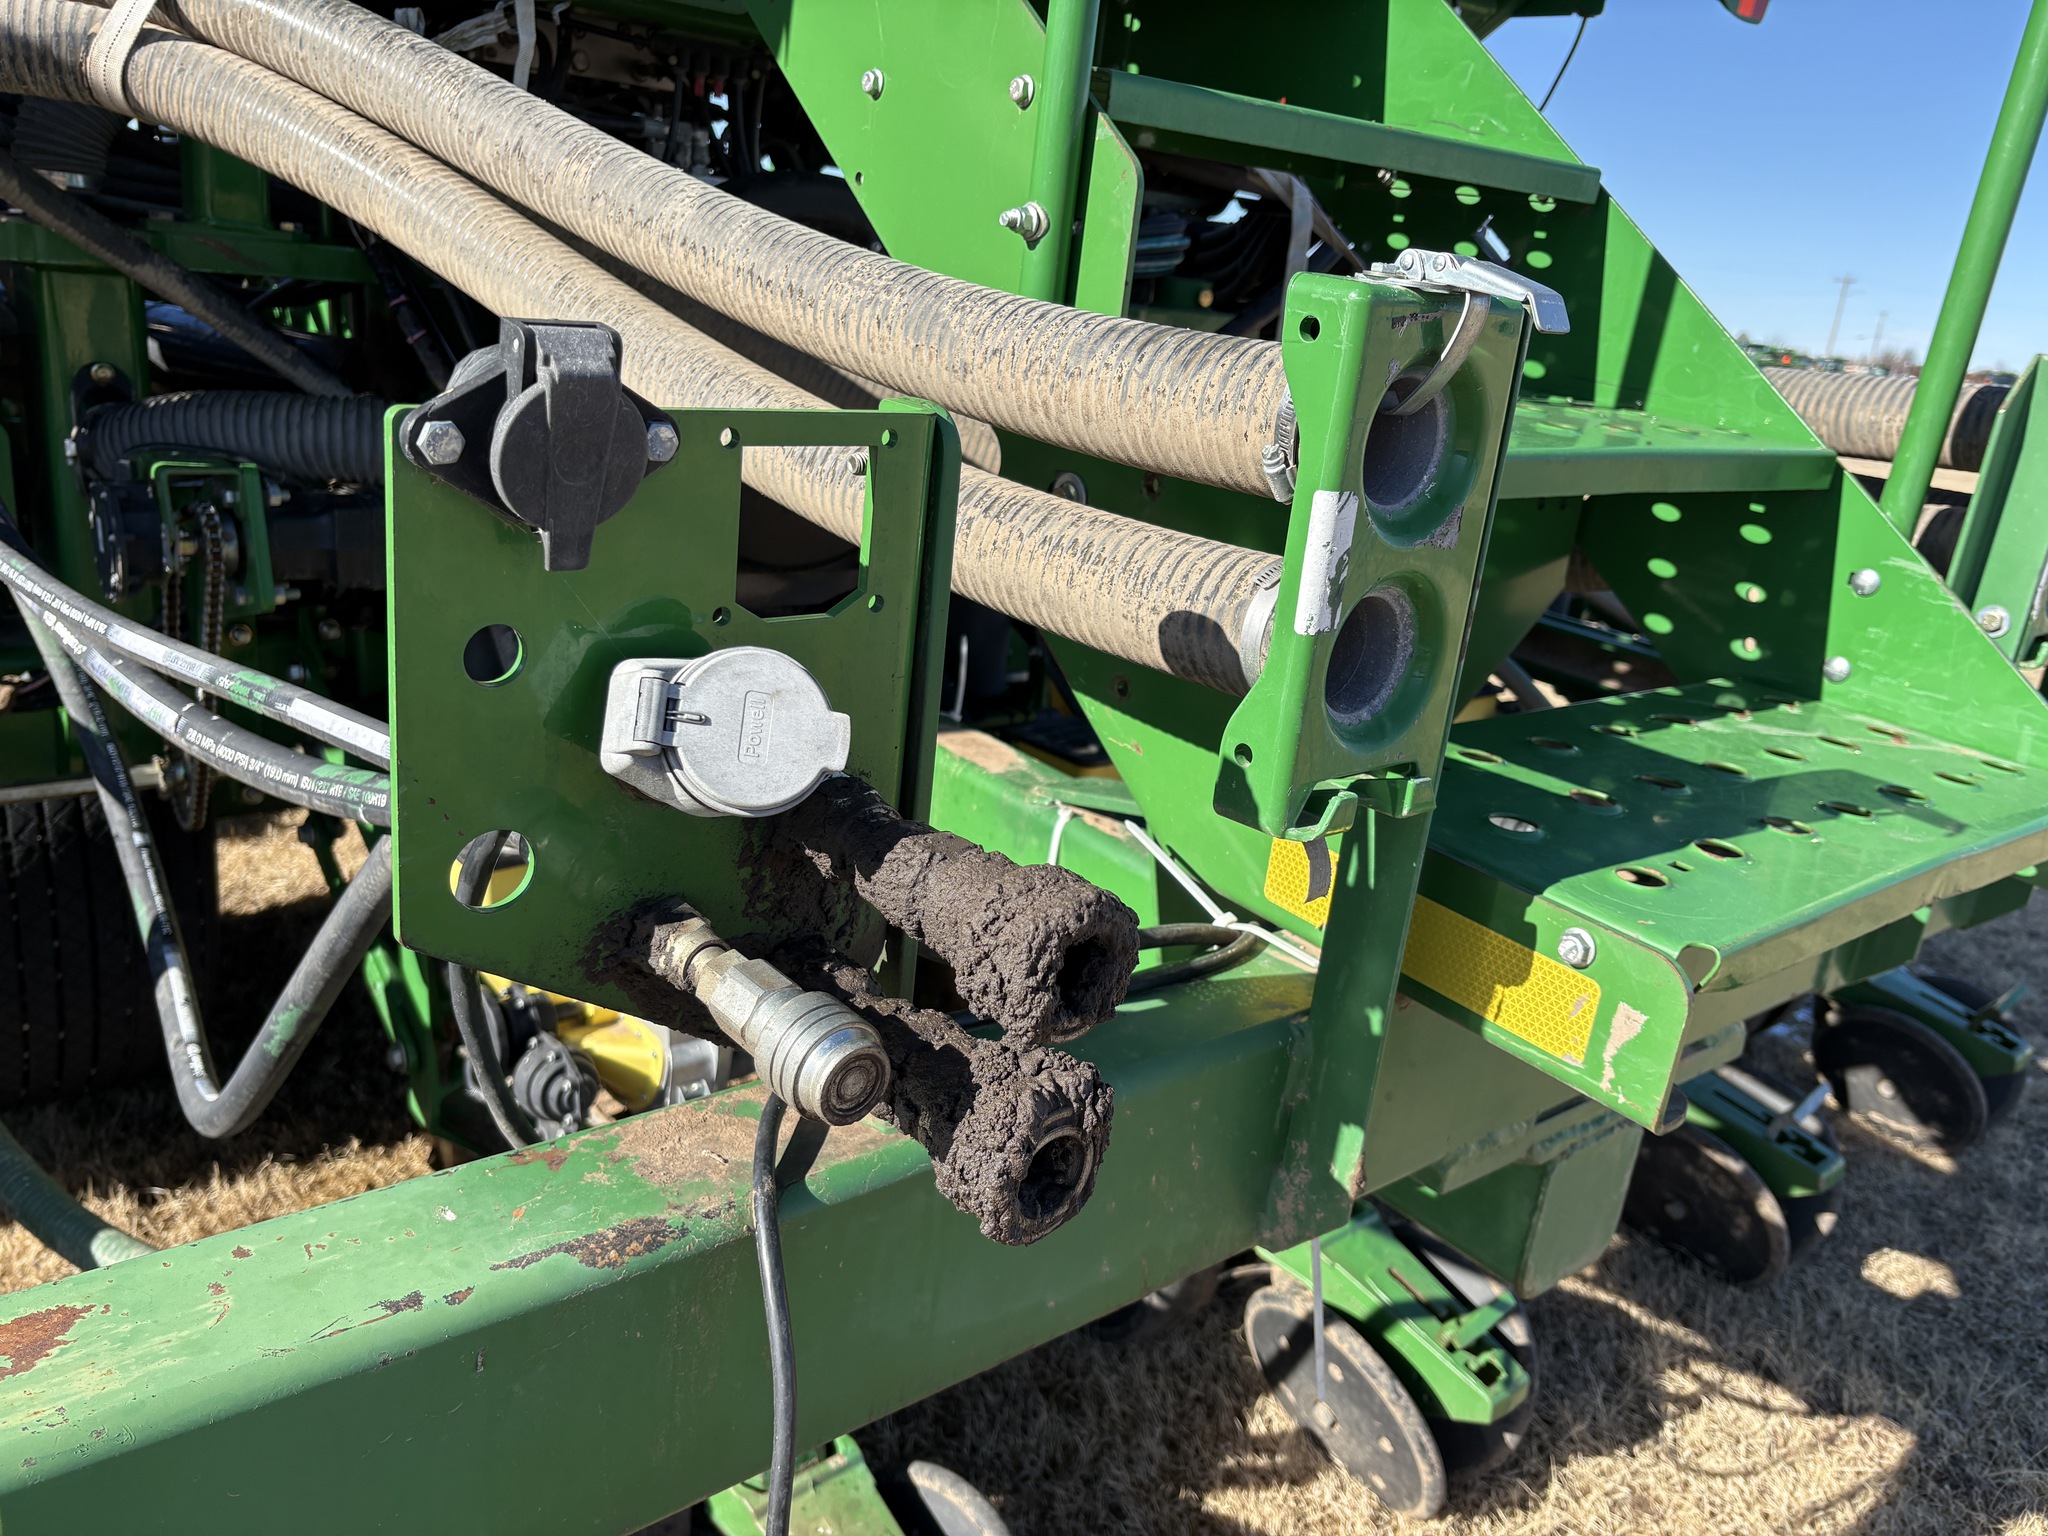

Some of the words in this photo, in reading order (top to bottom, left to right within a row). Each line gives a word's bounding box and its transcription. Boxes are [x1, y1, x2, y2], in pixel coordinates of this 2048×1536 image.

[744, 699, 766, 758] Powell
[200, 735, 217, 751] MPa
[215, 742, 234, 761] (4000
[233, 750, 249, 769] PSI)
[248, 757, 264, 774] 3/4"
[263, 763, 282, 781] (19.0
[282, 770, 299, 787] mm)
